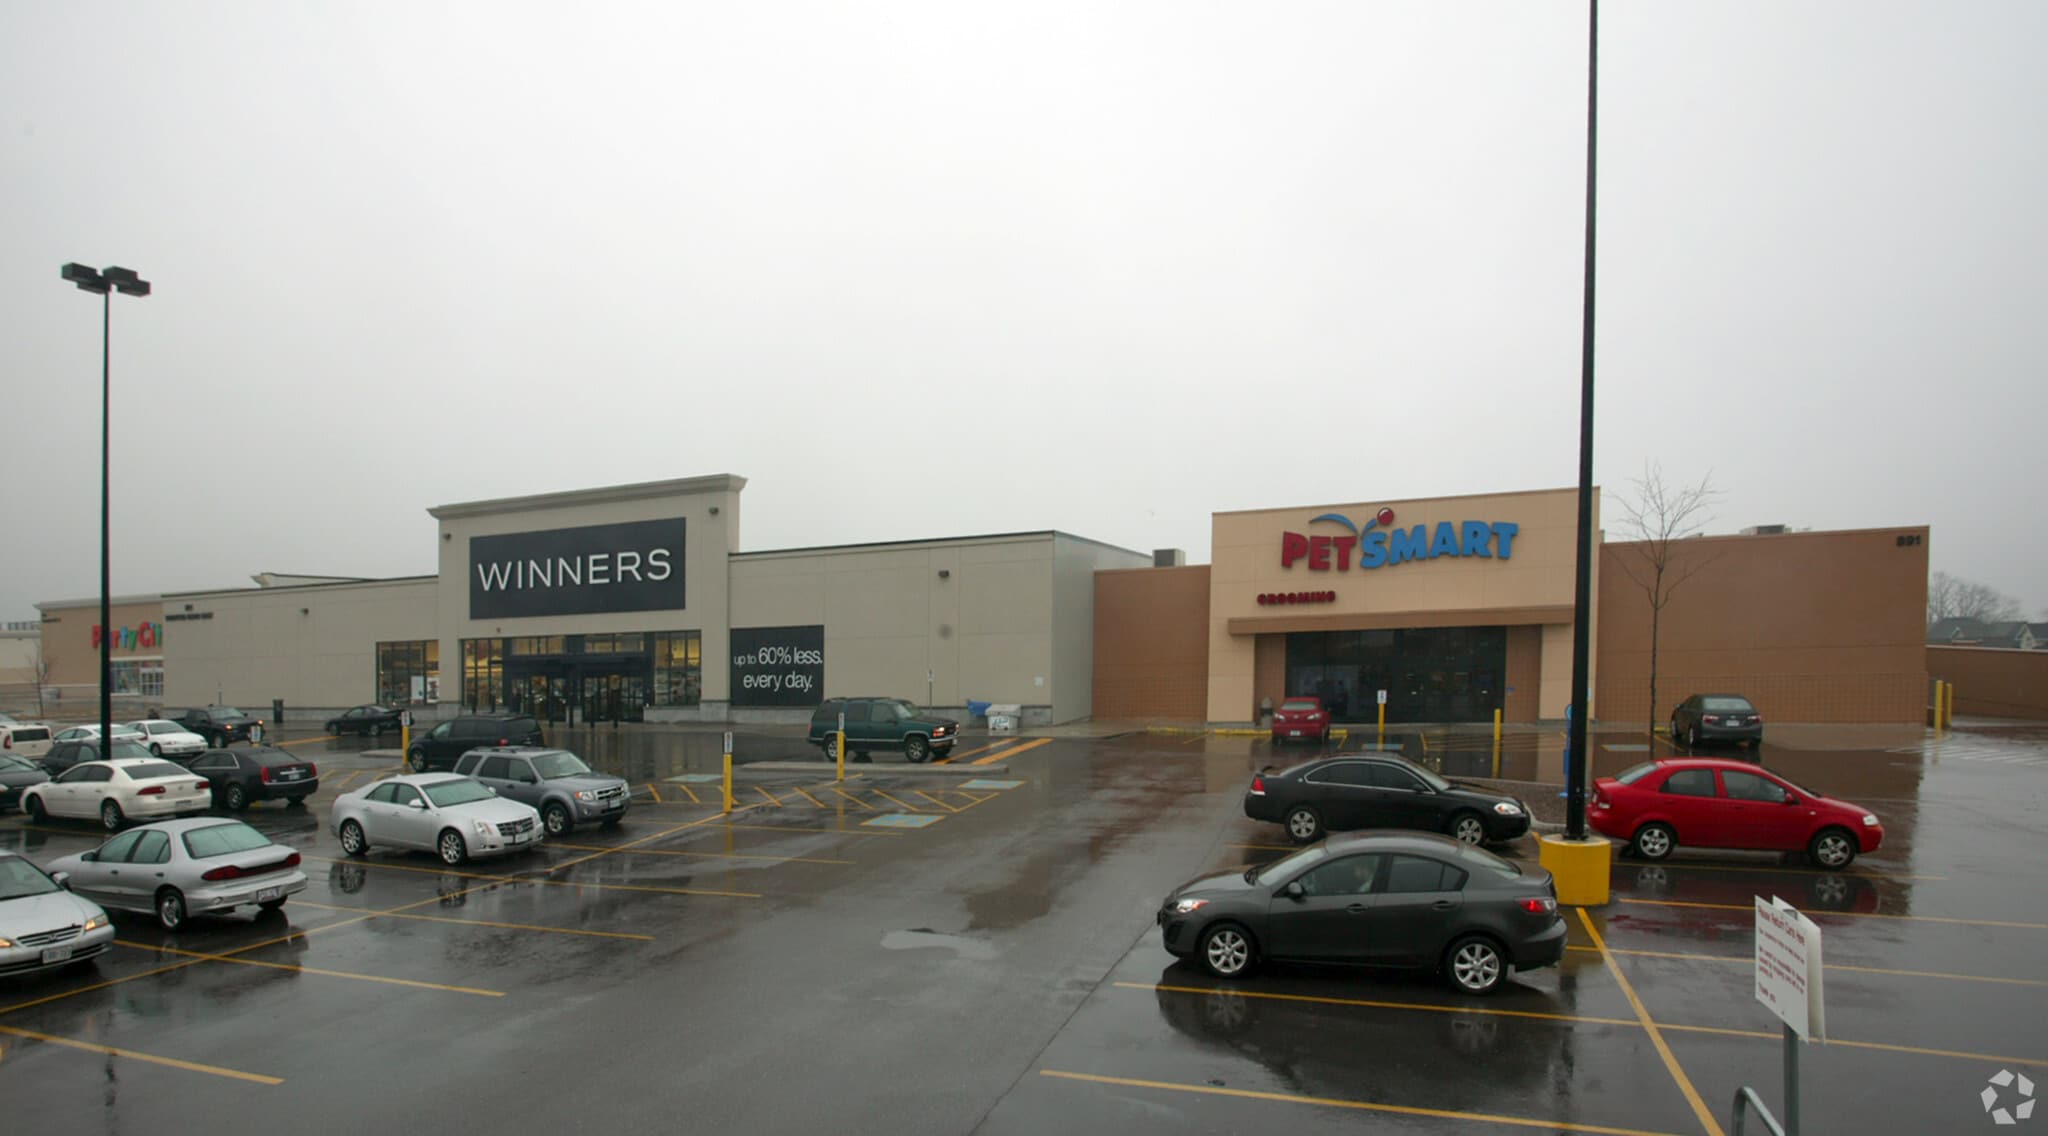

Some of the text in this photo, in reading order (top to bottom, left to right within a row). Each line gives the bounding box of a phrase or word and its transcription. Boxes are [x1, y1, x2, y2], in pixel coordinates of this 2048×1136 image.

[1282, 520, 1518, 571] PETSMART
[477, 549, 671, 591] WINNERS
[1256, 591, 1336, 605] GROOMING
[734, 646, 823, 667] up to 60% less.
[743, 670, 813, 692] every day.
